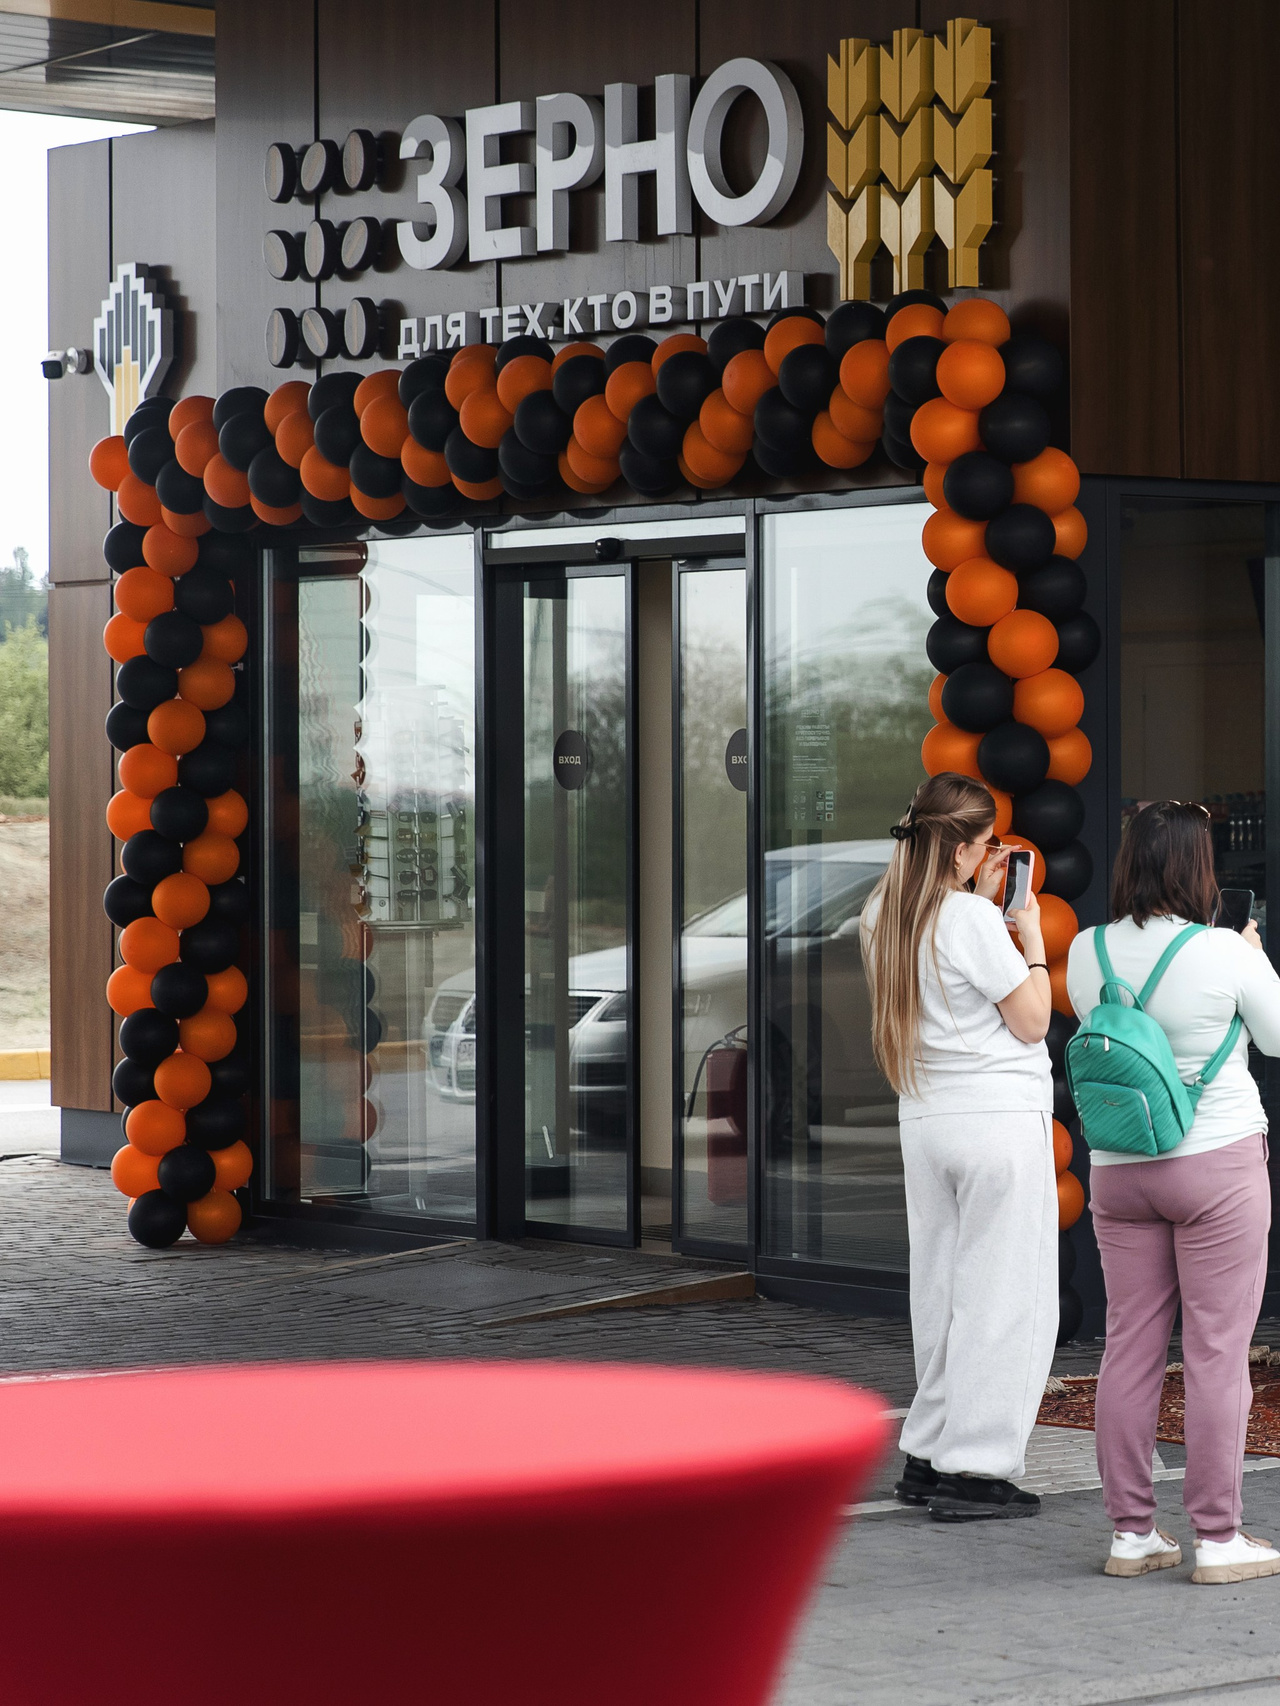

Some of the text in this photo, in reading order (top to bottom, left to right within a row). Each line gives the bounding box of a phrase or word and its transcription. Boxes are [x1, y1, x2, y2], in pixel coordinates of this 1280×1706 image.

[396, 57, 804, 271] ЗЕРНО
[397, 311, 472, 360] ДЛЯ
[563, 290, 642, 335] КТО
[649, 285, 676, 324] В
[686, 270, 795, 321] ПУТИ
[558, 755, 582, 765] ВХОД
[731, 755, 747, 764] ВХО
